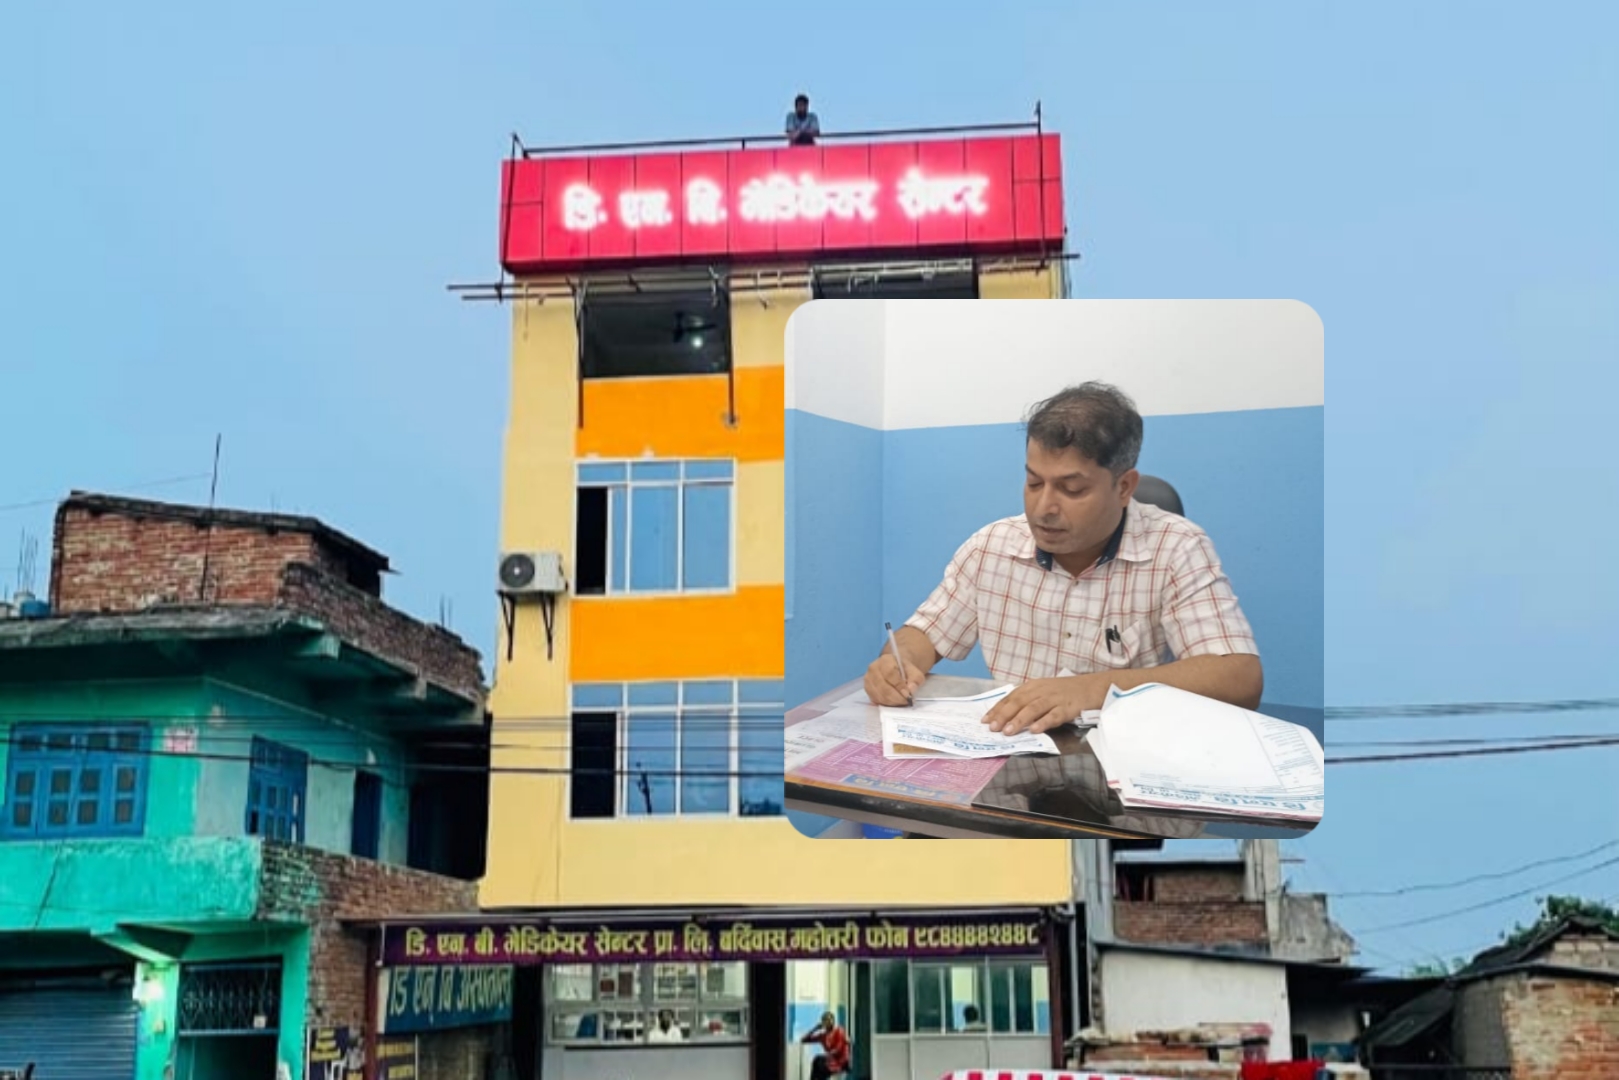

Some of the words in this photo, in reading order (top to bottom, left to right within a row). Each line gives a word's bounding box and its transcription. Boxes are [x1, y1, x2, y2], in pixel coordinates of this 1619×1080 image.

[405, 927, 431, 957] डि.
[503, 924, 590, 956] मेडिकेयर
[593, 924, 649, 956] सेन्टर
[653, 930, 678, 956] प्रा.
[865, 918, 909, 949] फोन
